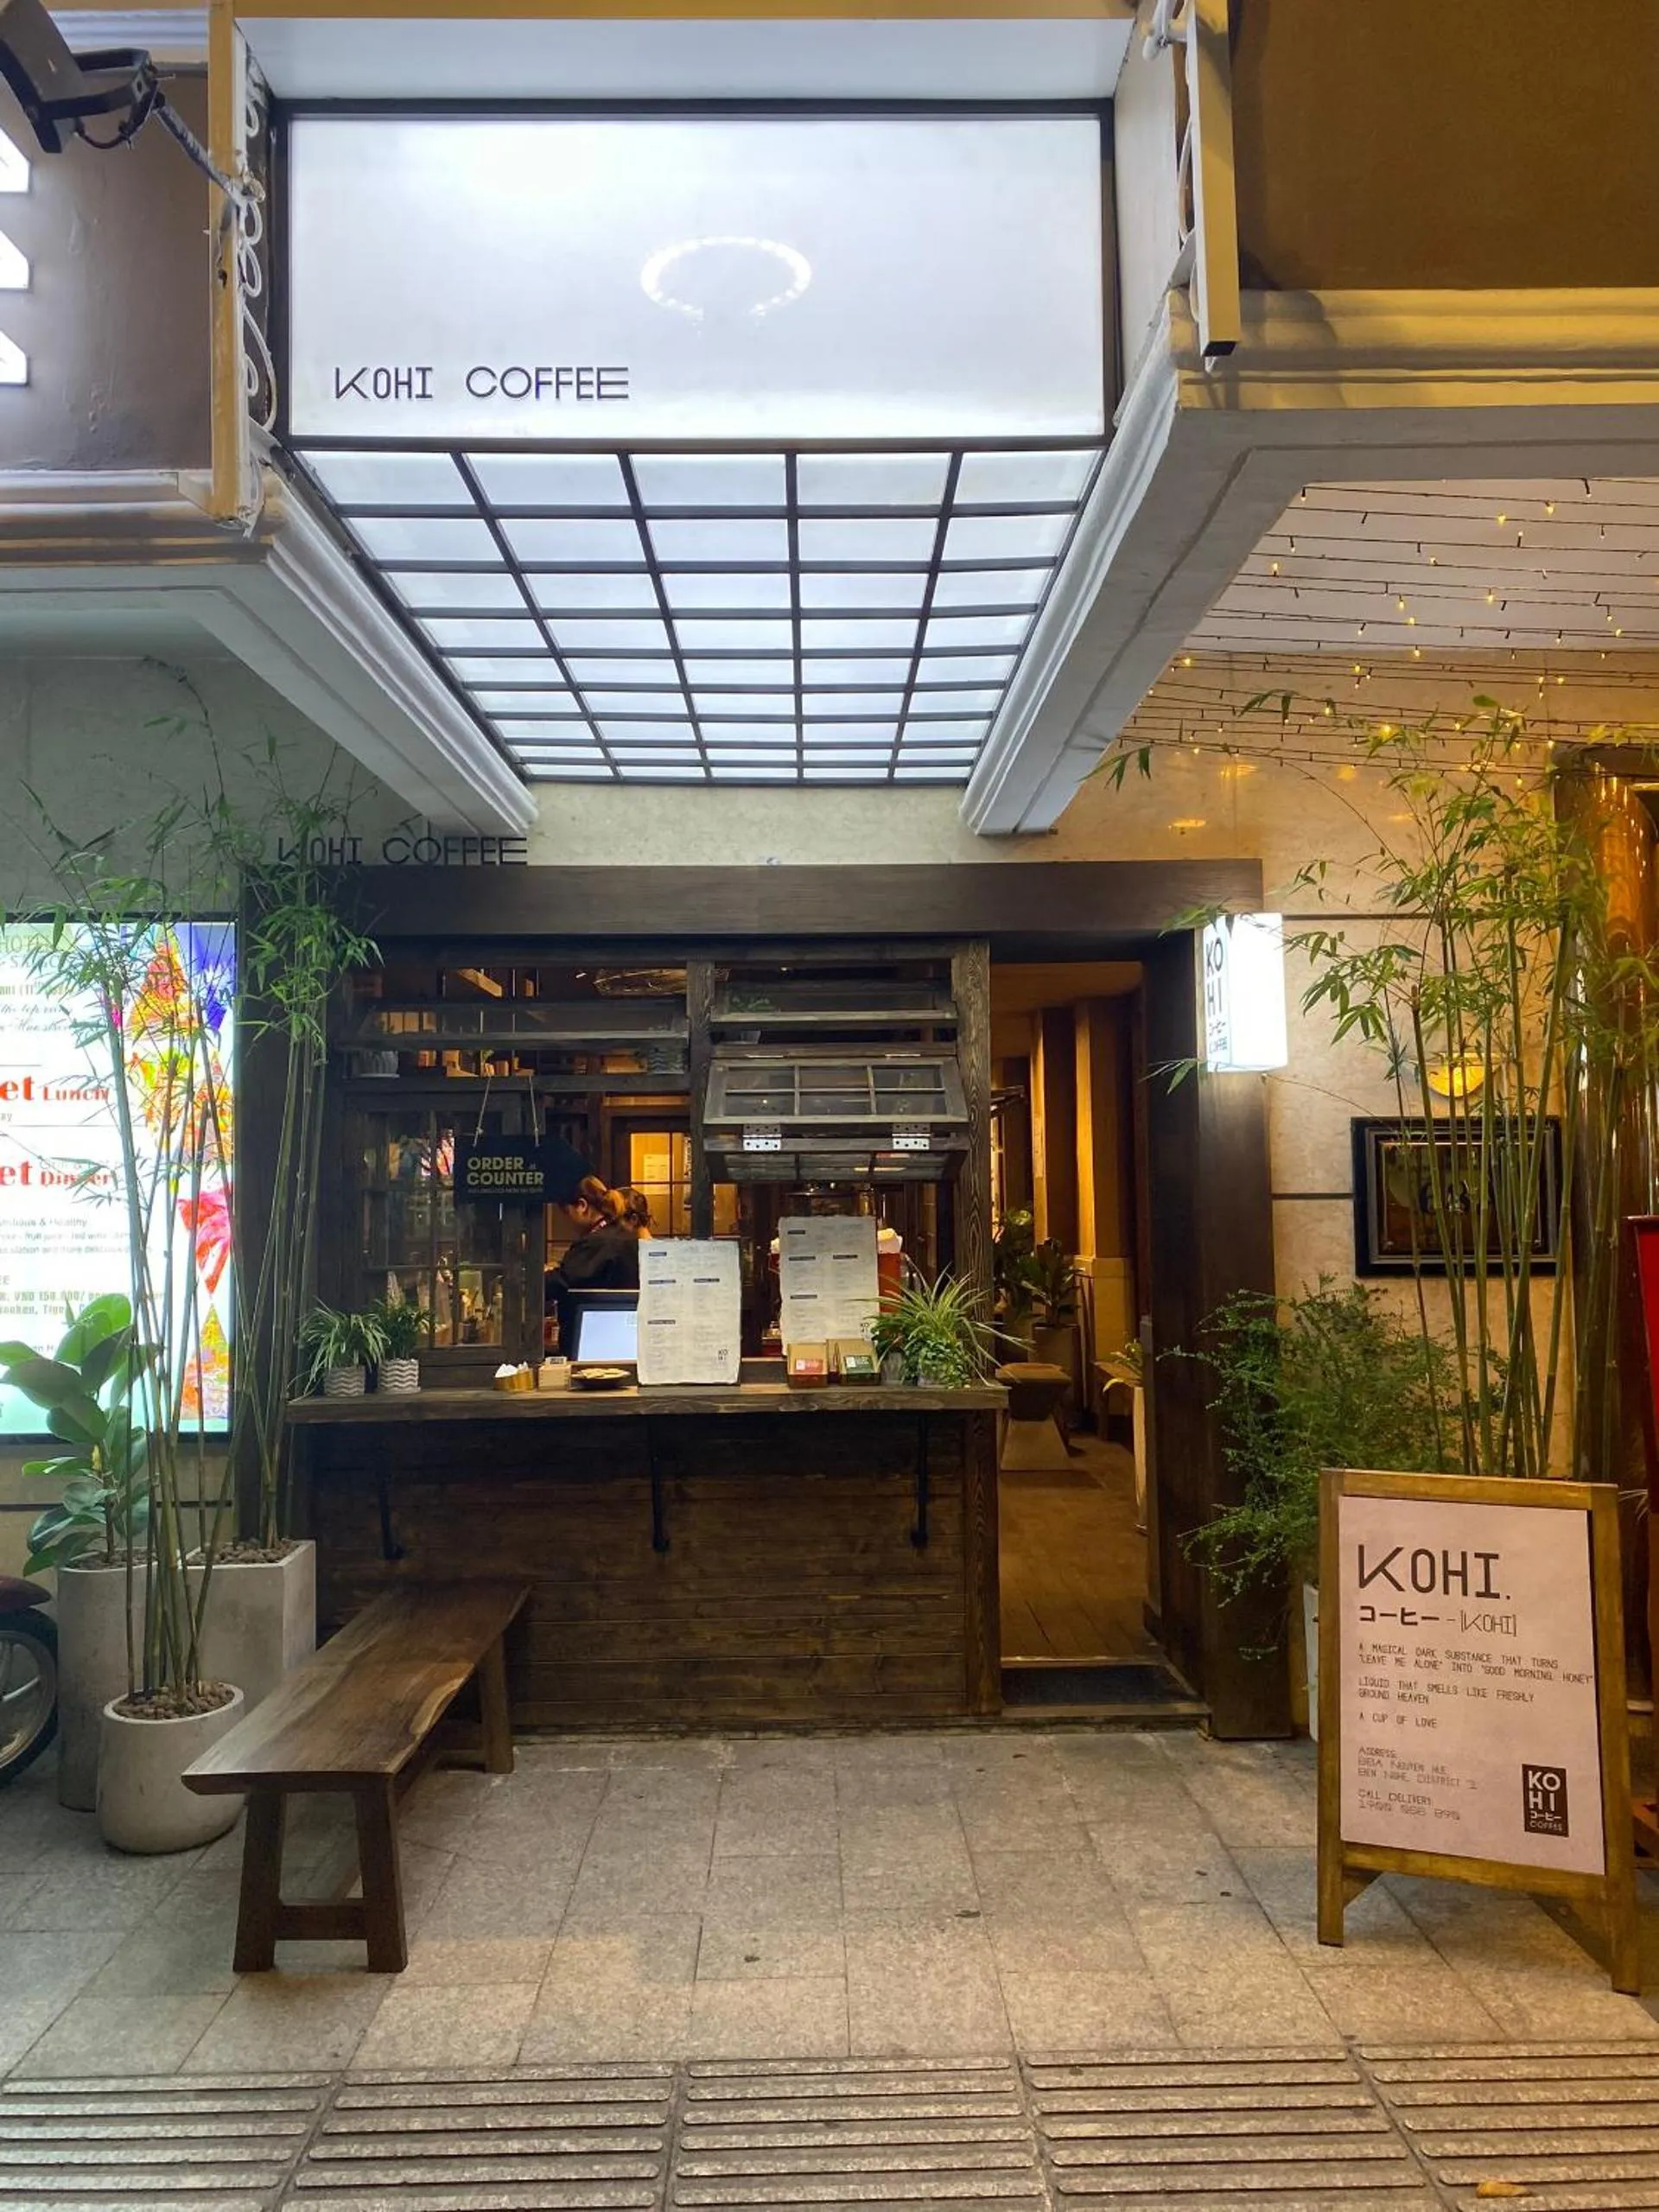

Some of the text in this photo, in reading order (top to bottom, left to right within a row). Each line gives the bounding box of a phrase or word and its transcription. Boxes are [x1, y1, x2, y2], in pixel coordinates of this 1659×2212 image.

[335, 366, 629, 399] KOHI COFFEE
[383, 836, 527, 865] COFFEE
[1206, 938, 1224, 977] KO
[1207, 977, 1223, 1017] HI
[467, 1157, 524, 1170] ORDER
[467, 1172, 544, 1185] COUNTER
[1357, 1544, 1510, 1599] KOHI.
[1360, 1605, 1440, 1625] コーヒー
[1415, 1647, 1438, 1658] DARK
[1445, 1649, 1493, 1662] SUBSTANCE
[1502, 1655, 1522, 1665] THAT
[1532, 1657, 1559, 1669] TURNS
[1452, 1662, 1472, 1673] INTO
[1358, 1676, 1535, 1702] LIQUID THAT SMELLS LIKE FRESHLY
[1358, 1688, 1430, 1704] GROUND HEAVEN
[1359, 1712, 1437, 1729] A CUP OF LOVE
[1529, 1770, 1560, 1791] KO
[1357, 1789, 1381, 1800] CALL
[1529, 1790, 1555, 1812] HI
[1530, 1810, 1562, 1821] コーヒー
